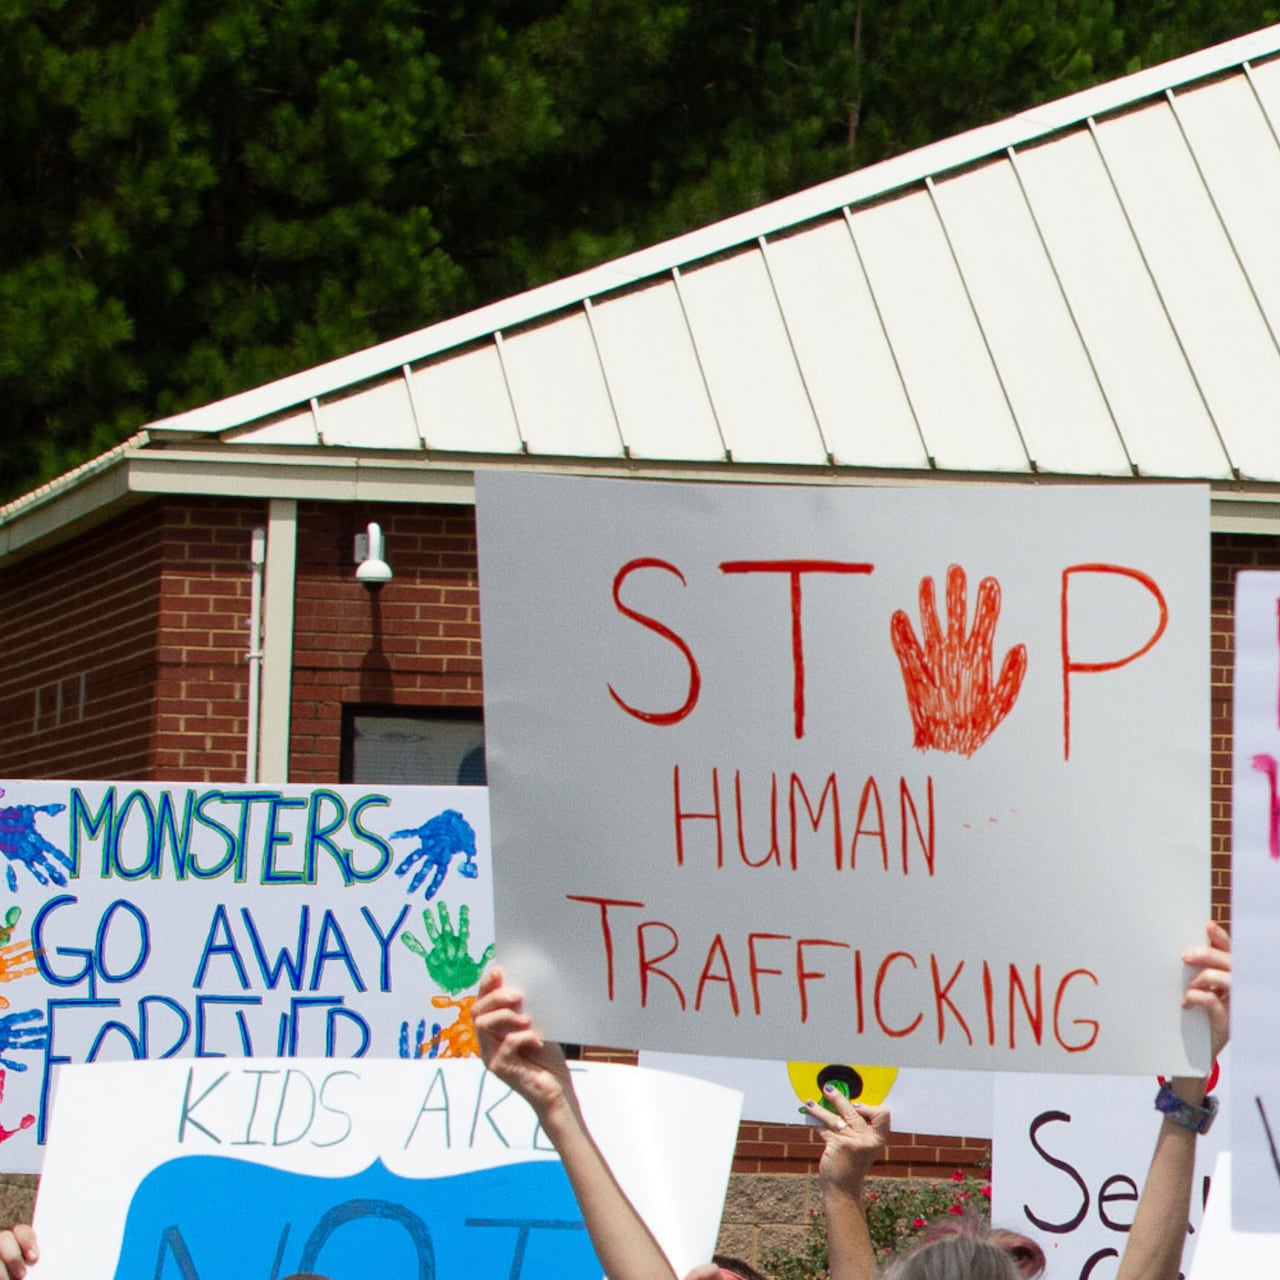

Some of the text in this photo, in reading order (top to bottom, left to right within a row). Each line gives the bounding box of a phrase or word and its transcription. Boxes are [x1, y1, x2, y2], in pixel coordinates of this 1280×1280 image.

[69, 787, 393, 885] MONSTERS
[674, 765, 934, 876] HUMAN
[31, 895, 412, 1000] GO AWAY
[567, 895, 1099, 1053] TRAFFICKING
[177, 1066, 361, 1148] KIDS
